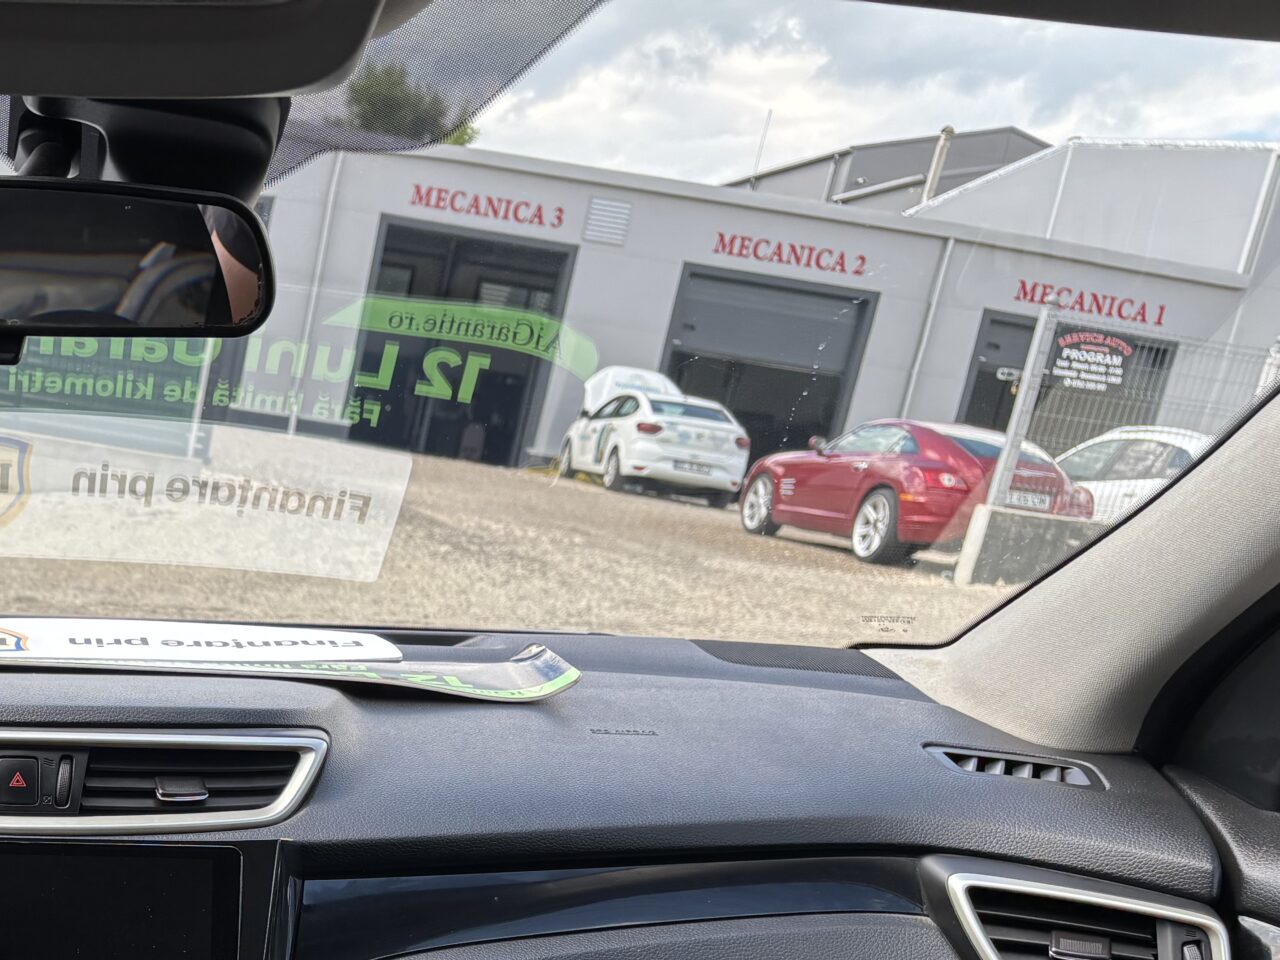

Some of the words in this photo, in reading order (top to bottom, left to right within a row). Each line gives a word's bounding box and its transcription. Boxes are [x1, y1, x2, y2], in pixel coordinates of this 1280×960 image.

[408, 184, 546, 226] MECANICA
[549, 206, 565, 229] 3
[713, 232, 847, 273] MECANICA
[852, 254, 867, 276] 2
[1014, 279, 1149, 325] MECANICA
[1154, 303, 1167, 326] 1
[1062, 347, 1123, 366] PROGRAM
